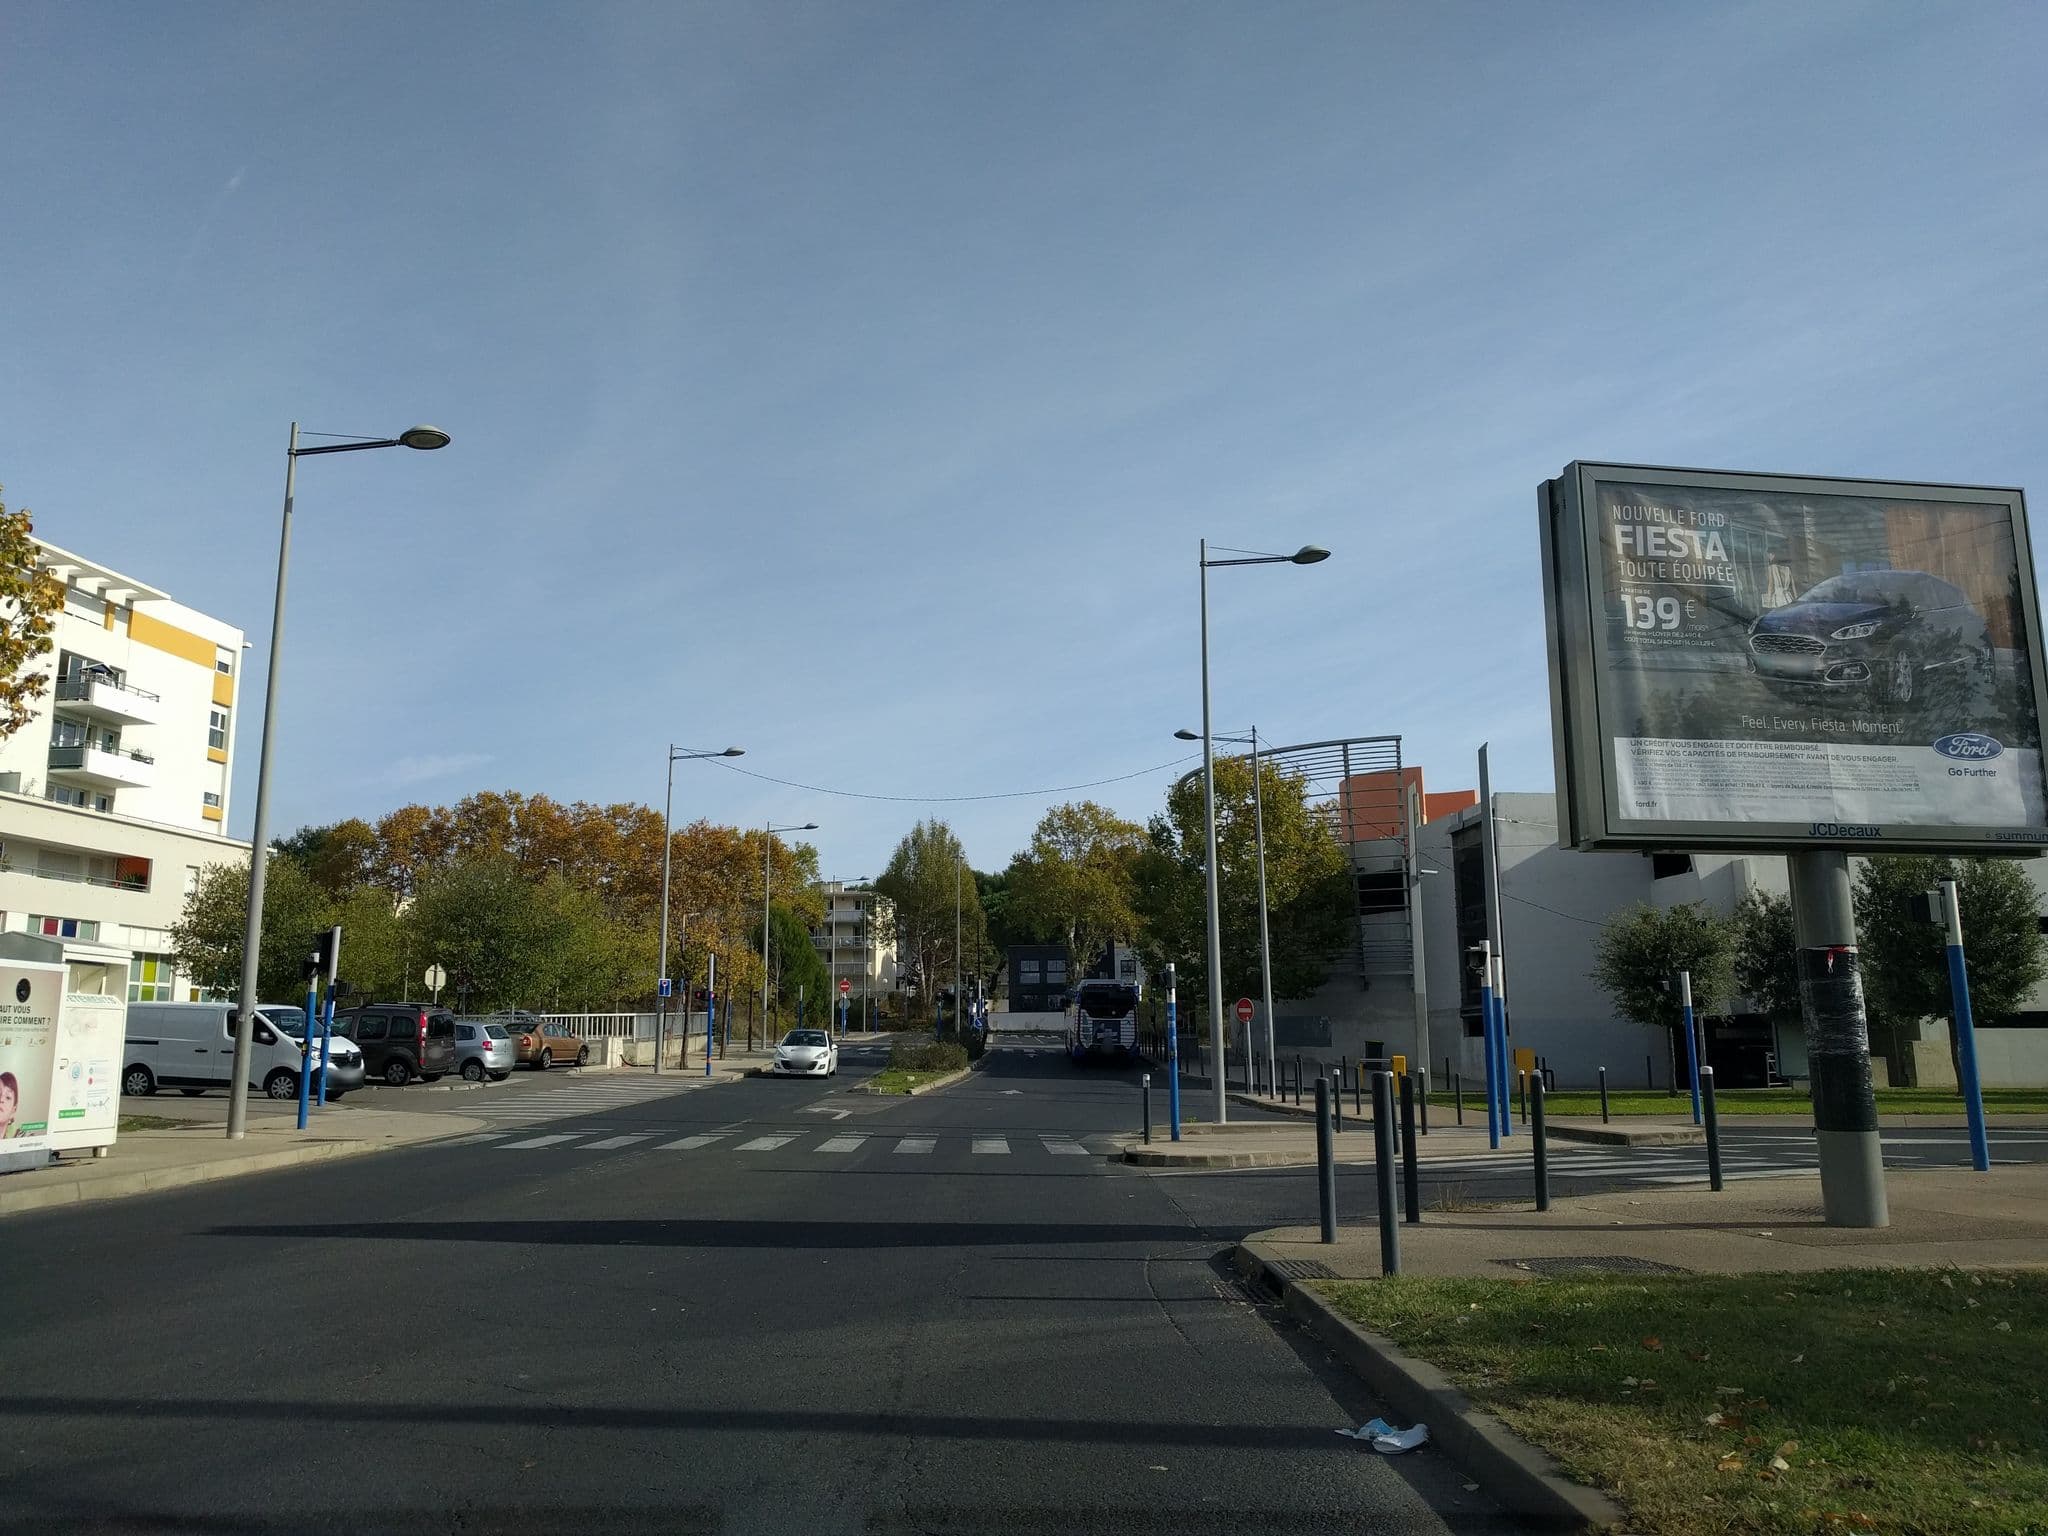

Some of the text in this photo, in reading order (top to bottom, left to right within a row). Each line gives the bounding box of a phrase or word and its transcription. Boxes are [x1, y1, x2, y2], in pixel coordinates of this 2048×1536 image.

[1612, 504, 1725, 527] NOUVELLE FORD
[1614, 524, 1729, 562] FIESTA
[1618, 560, 1735, 582] TOUTE ÉQUIPÉE
[1620, 594, 1697, 630] 139 €
[1741, 715, 1770, 729] Feel.
[1773, 717, 1808, 732] Every.
[1811, 718, 1849, 732] Fiesta.
[1643, 740, 1670, 748] CRÉDIT
[1692, 741, 1724, 749] ENGAGE
[1754, 742, 1773, 750] ÊTRE
[1948, 736, 1991, 756] Ford
[1631, 748, 1664, 756] VÉRIFIEZ
[1682, 750, 1726, 758] CAPACITÉS
[1737, 751, 1804, 760] REMBOURSEMENT
[1948, 767, 1997, 777] Go Further
[1808, 822, 1882, 837] JCDecaux
[13, 1006, 31, 1014] VOUS
[14, 1017, 45, 1025] COMMENT
[47, 1017, 51, 1025] ?
